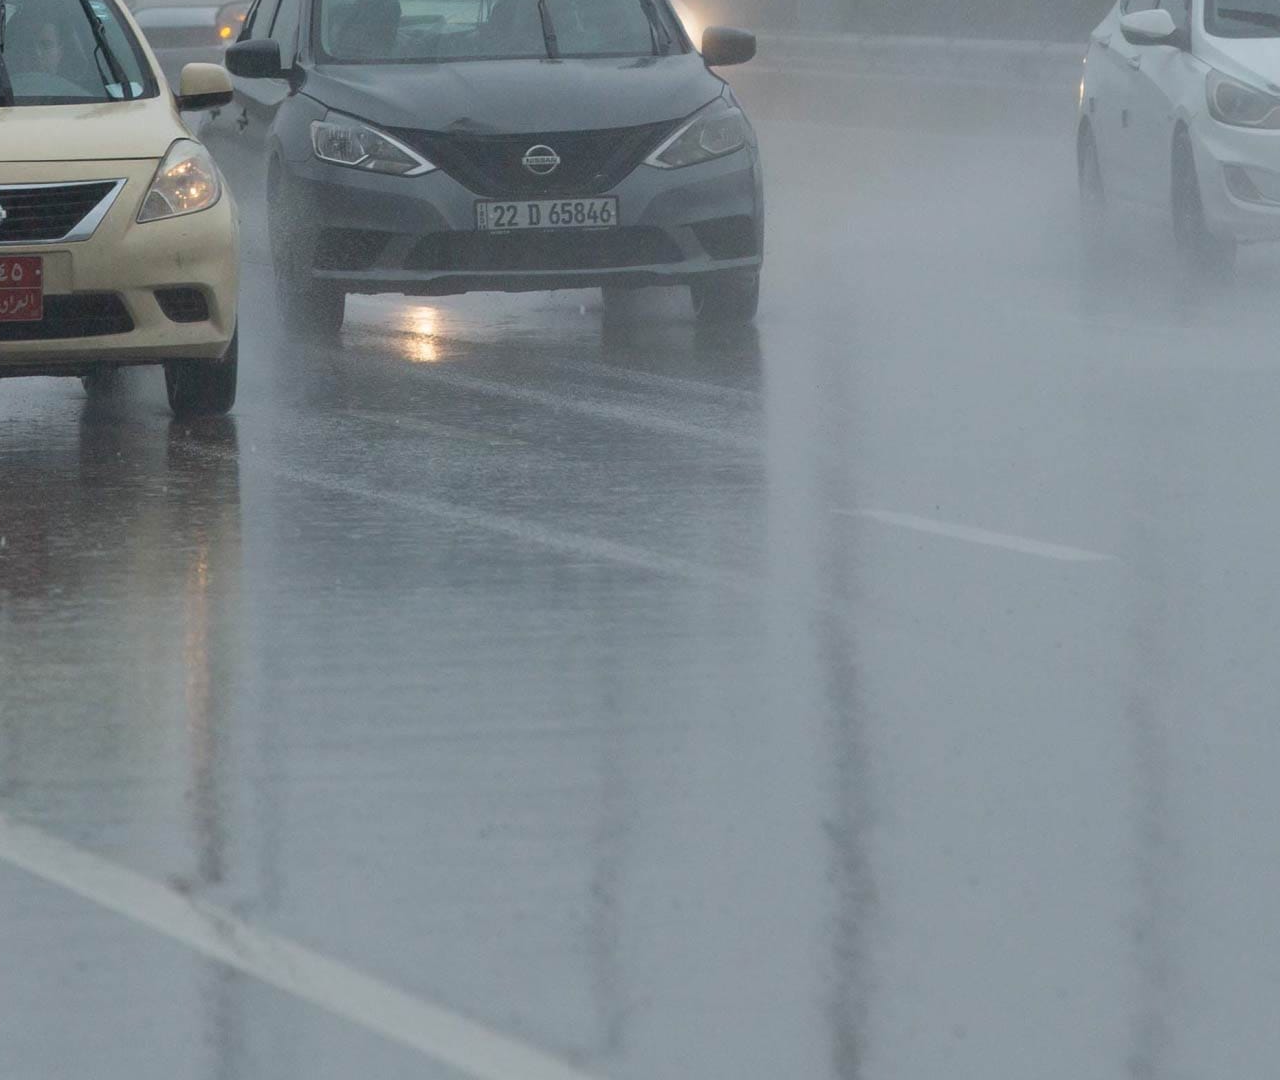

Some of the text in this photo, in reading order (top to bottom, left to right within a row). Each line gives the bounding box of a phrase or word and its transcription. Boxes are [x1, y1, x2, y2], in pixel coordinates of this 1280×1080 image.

[494, 205, 518, 227] 22
[527, 203, 541, 226] D
[549, 201, 611, 224] 65846
